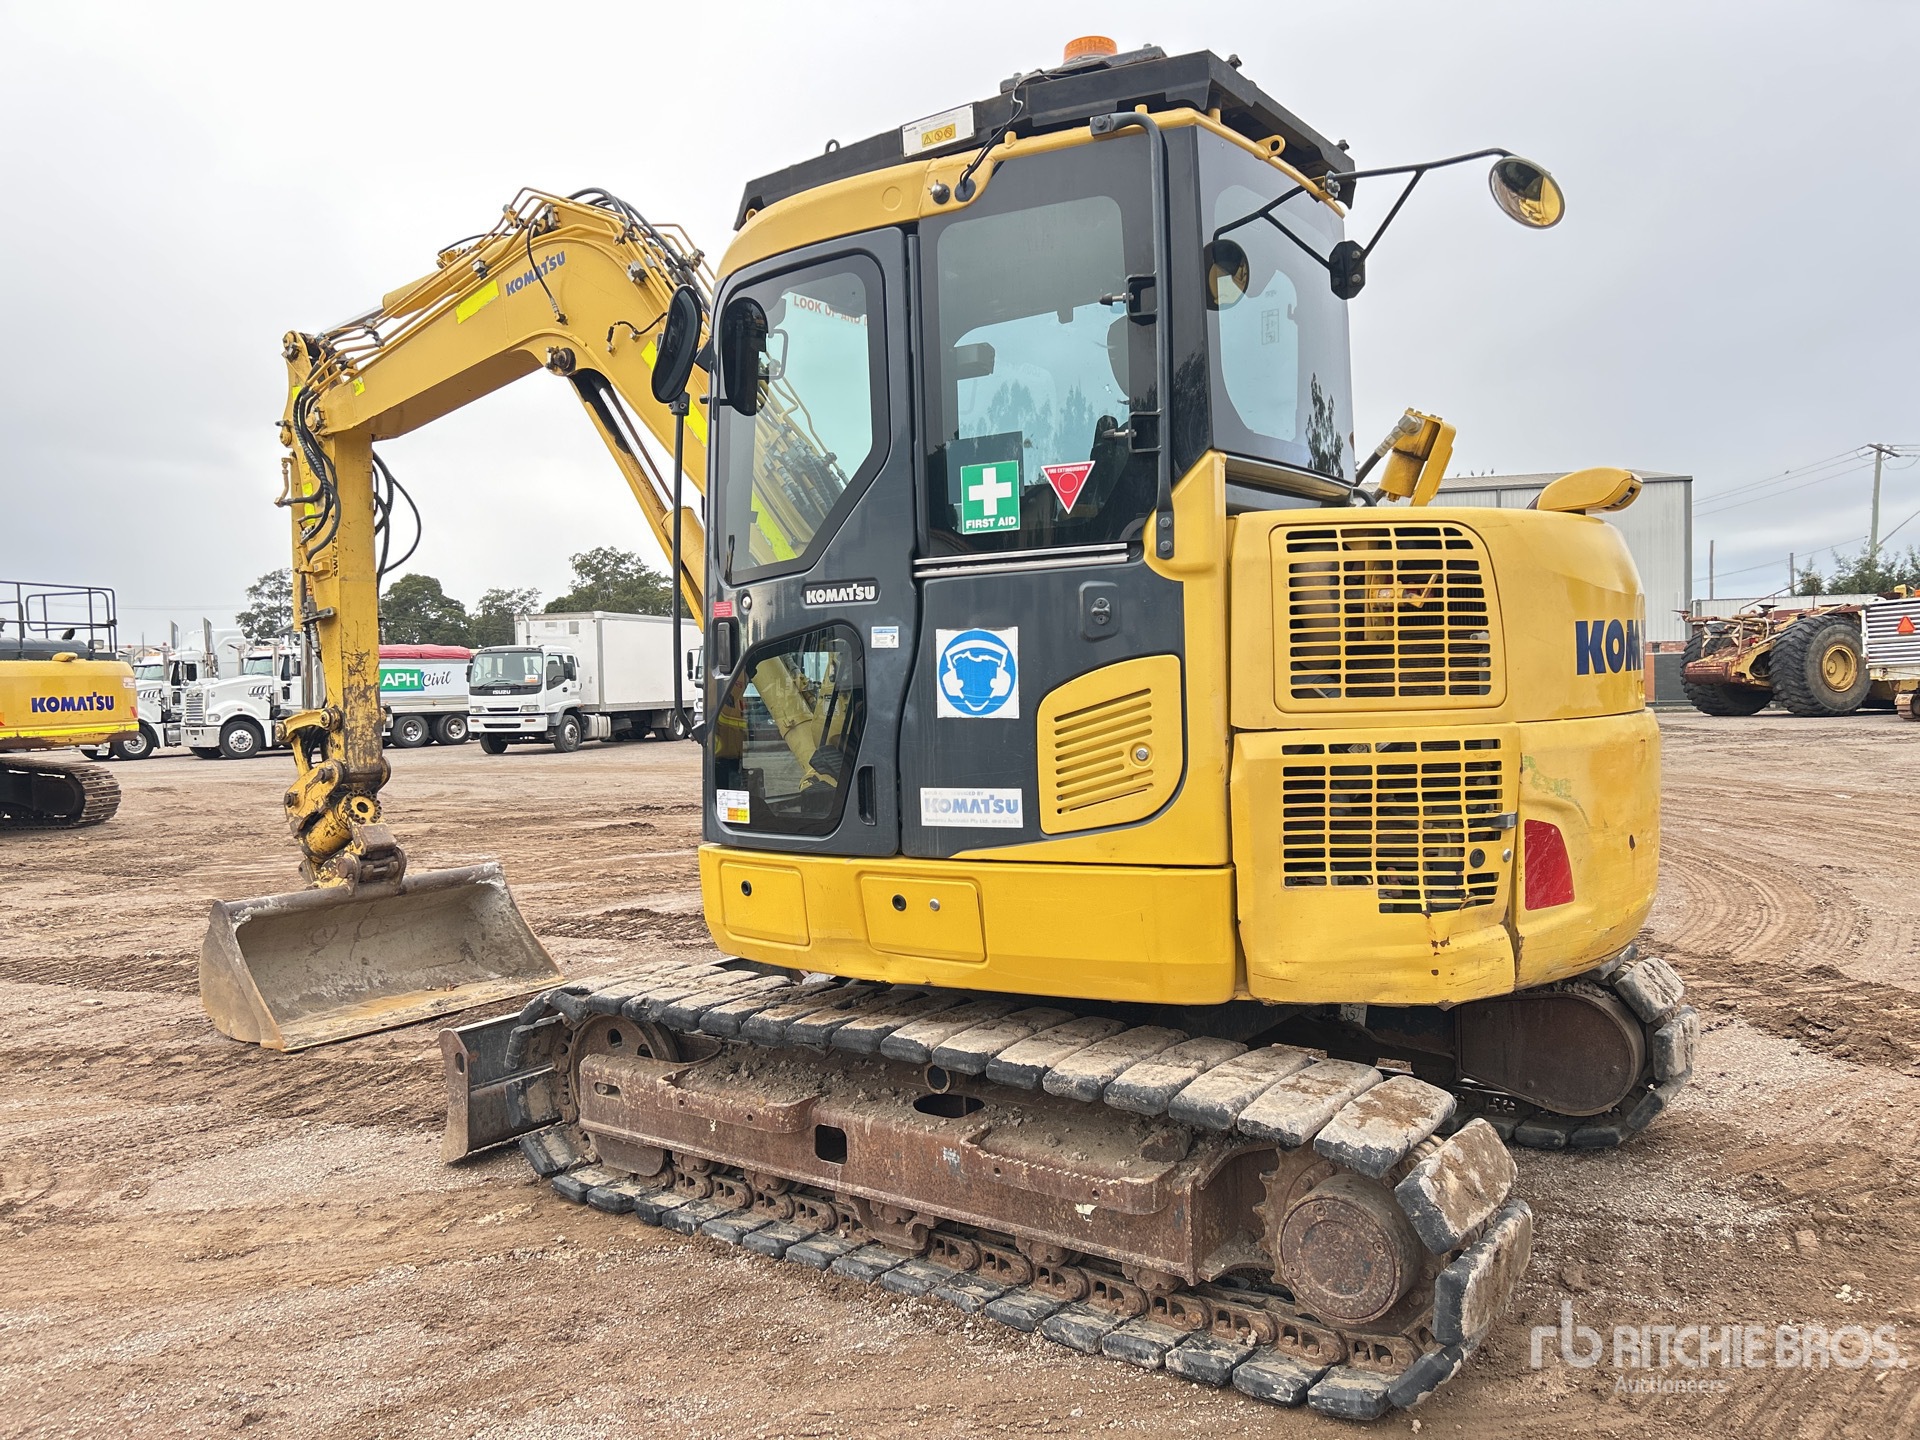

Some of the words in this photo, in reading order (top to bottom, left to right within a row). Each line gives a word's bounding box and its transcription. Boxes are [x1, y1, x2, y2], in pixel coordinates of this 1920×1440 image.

[505, 250, 566, 297] KOMATSU
[793, 295, 822, 314] LOOK
[965, 518, 995, 529] FIRST
[998, 516, 1016, 526] AID
[806, 583, 876, 604] KOMATSU
[1575, 618, 1643, 676] KOM
[382, 673, 419, 687] APH
[422, 670, 451, 687] Civil
[31, 691, 115, 713] KOMATSU
[924, 794, 1019, 814] KOMATSU
